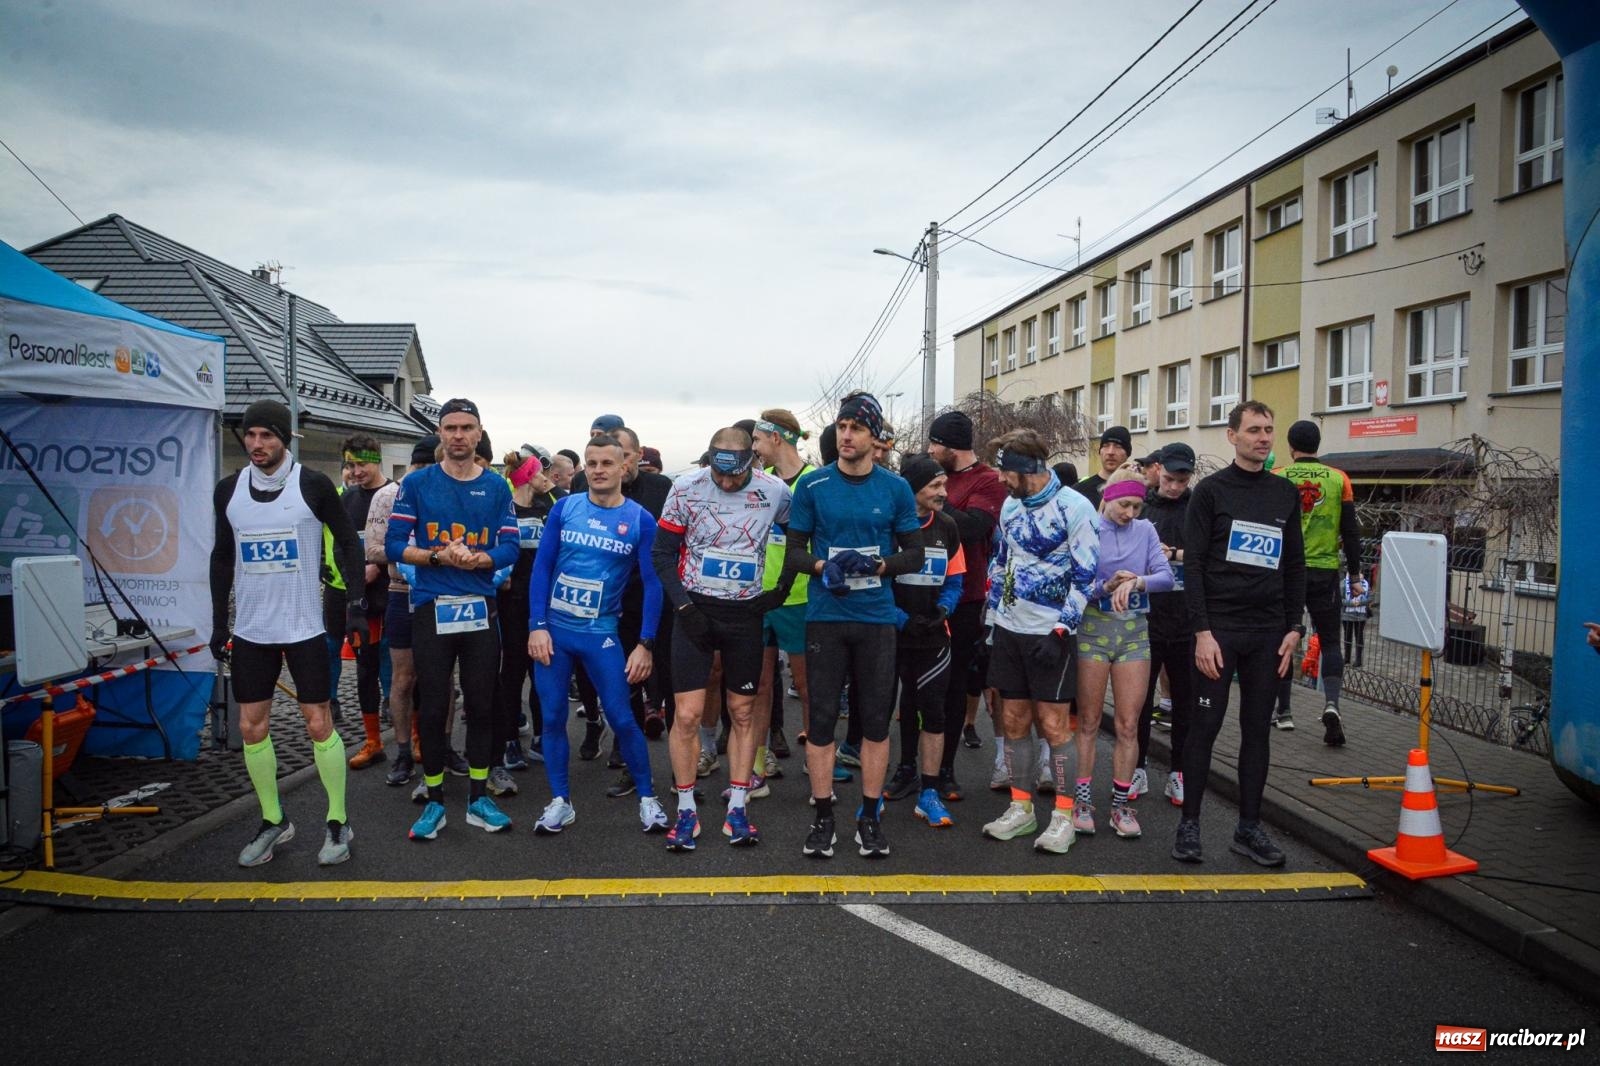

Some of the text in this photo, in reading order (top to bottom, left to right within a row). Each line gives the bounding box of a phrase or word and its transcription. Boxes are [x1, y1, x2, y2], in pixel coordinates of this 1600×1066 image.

[9, 333, 112, 369] PersonalBest
[1286, 471, 1330, 479] DZIKI
[249, 541, 289, 561] 134
[560, 529, 634, 556] RUNNERS
[1238, 533, 1275, 555] 220
[718, 561, 742, 579] 16
[560, 585, 593, 606] 114
[451, 603, 476, 621] 74
